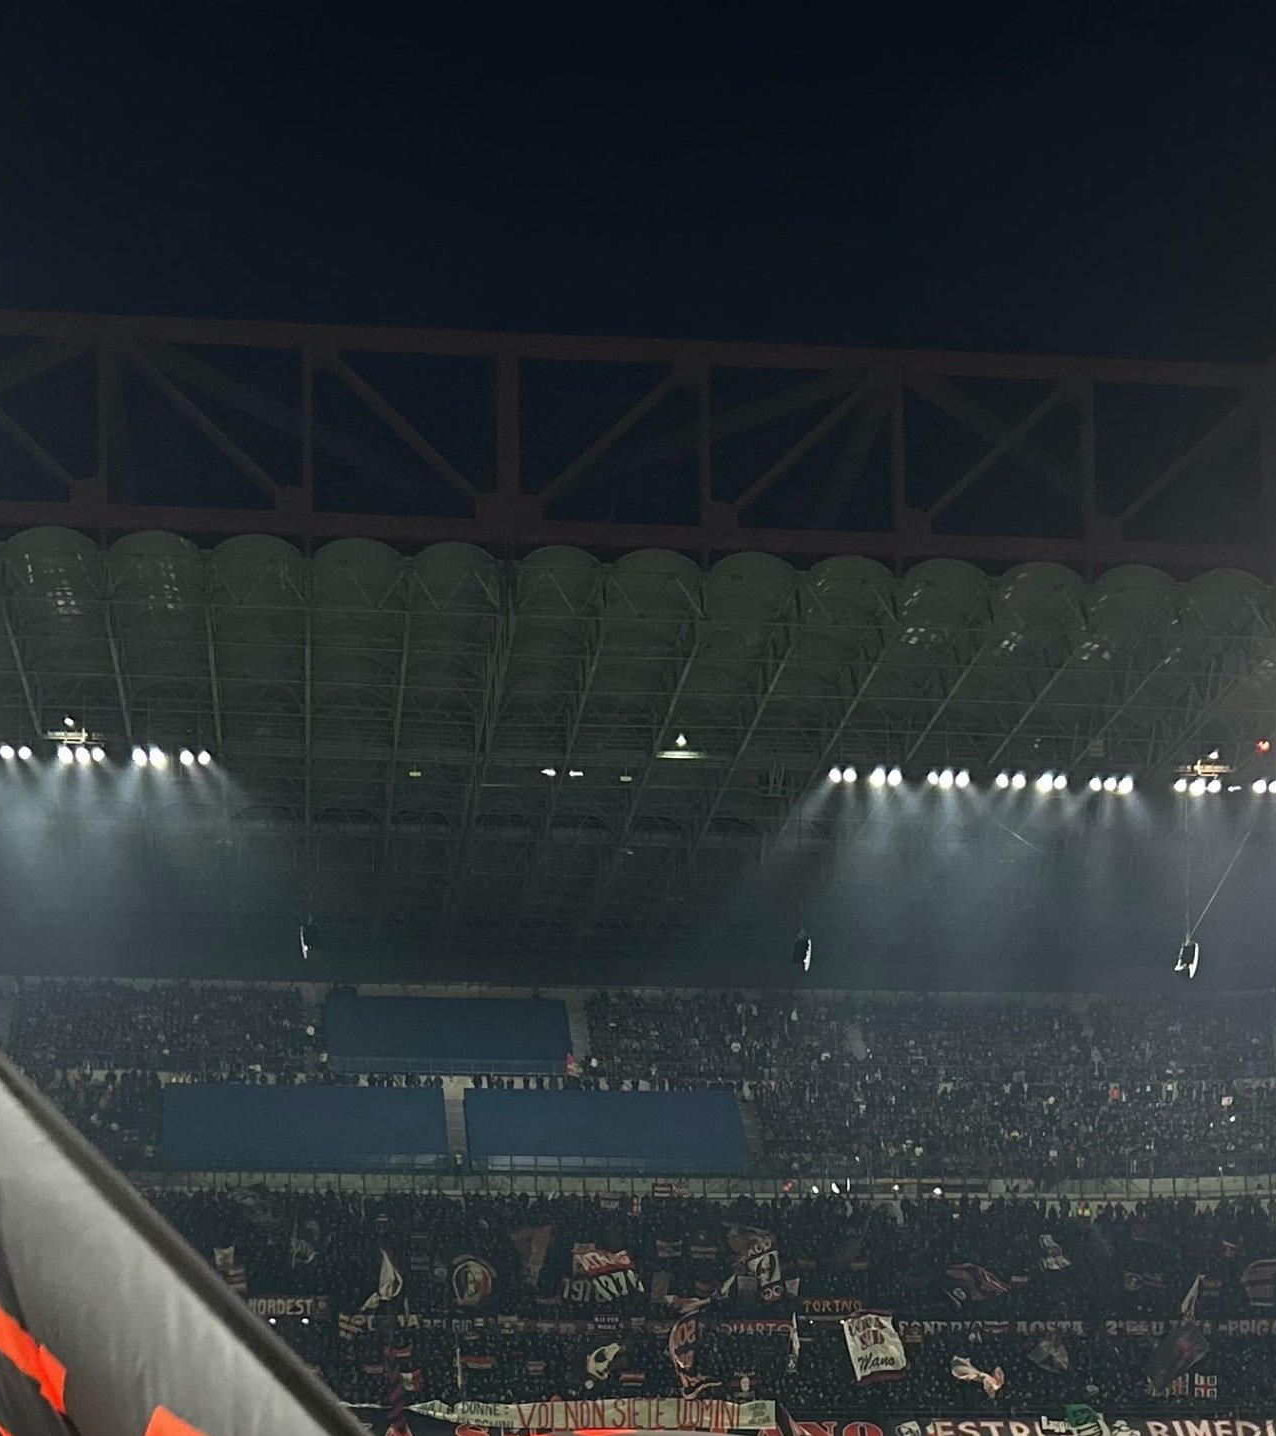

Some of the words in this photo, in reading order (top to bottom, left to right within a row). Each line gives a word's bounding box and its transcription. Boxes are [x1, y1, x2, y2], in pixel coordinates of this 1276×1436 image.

[803, 1300, 862, 1314] TORINO
[565, 1400, 605, 1429] NON
[612, 1398, 668, 1429] SIETE
